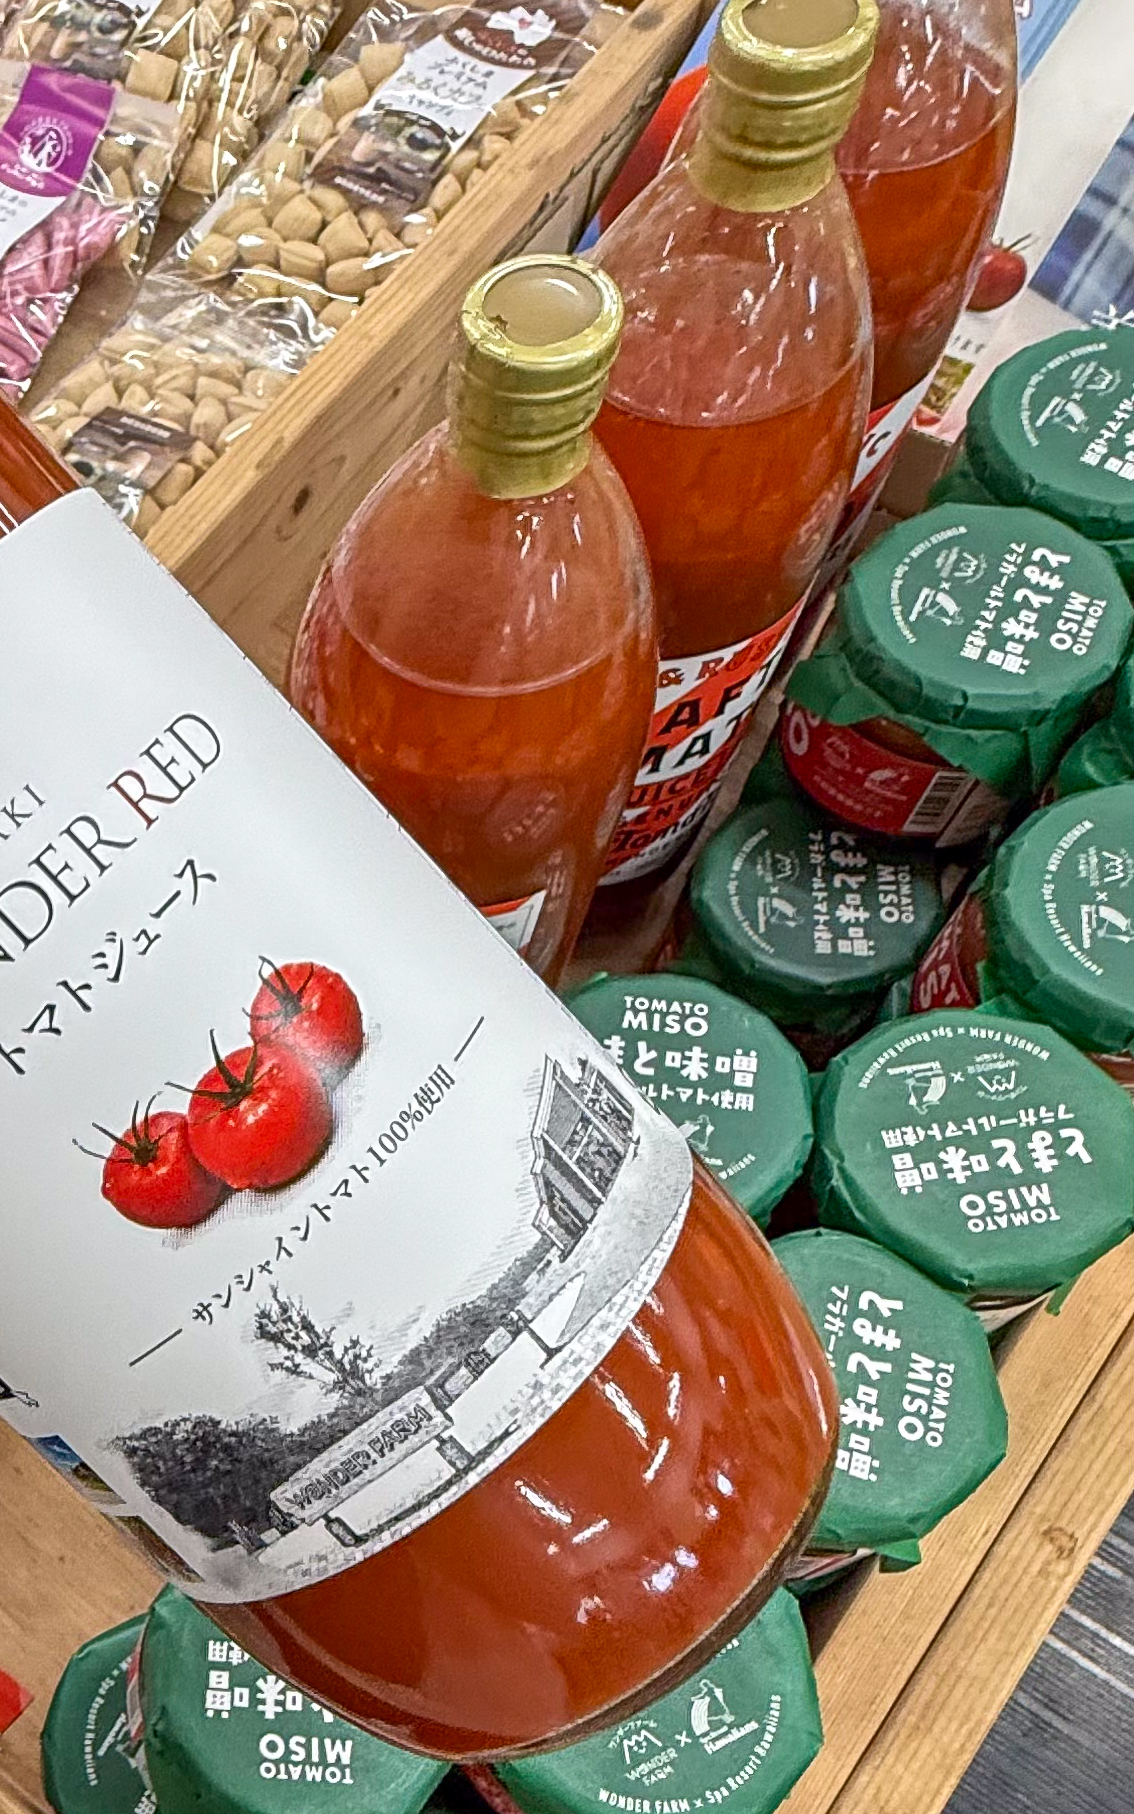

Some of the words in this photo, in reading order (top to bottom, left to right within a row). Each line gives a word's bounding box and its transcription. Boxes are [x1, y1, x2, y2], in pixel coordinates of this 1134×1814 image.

[986, 547, 1071, 675] とまと味噌
[1050, 591, 1091, 650] MISO
[1072, 599, 1107, 656] TOMATO
[107, 711, 222, 831] RED
[830, 831, 875, 956] とまと味噌
[877, 864, 900, 923] MISO
[898, 864, 914, 924] TOMATO
[622, 1010, 708, 1037] MISO
[624, 996, 709, 1015] TOMATO
[881, 1103, 1074, 1148] フラガールトマト使用
[892, 1128, 1092, 1195] とまと味噌
[960, 1183, 1052, 1216] MISO
[967, 1206, 1060, 1233] TOMATO
[835, 1291, 903, 1481] とまと味噌
[898, 1352, 935, 1441] MISO
[926, 1363, 955, 1447] TOMATO
[259, 1733, 353, 1765] MISO
[260, 1762, 354, 1784] TOMATO
[599, 1788, 651, 1813] WONDER
[655, 1798, 690, 1813] FARM
[705, 1785, 729, 1804] Spa
[726, 1755, 762, 1791] Resort
[753, 1695, 781, 1757] Hawaiians
